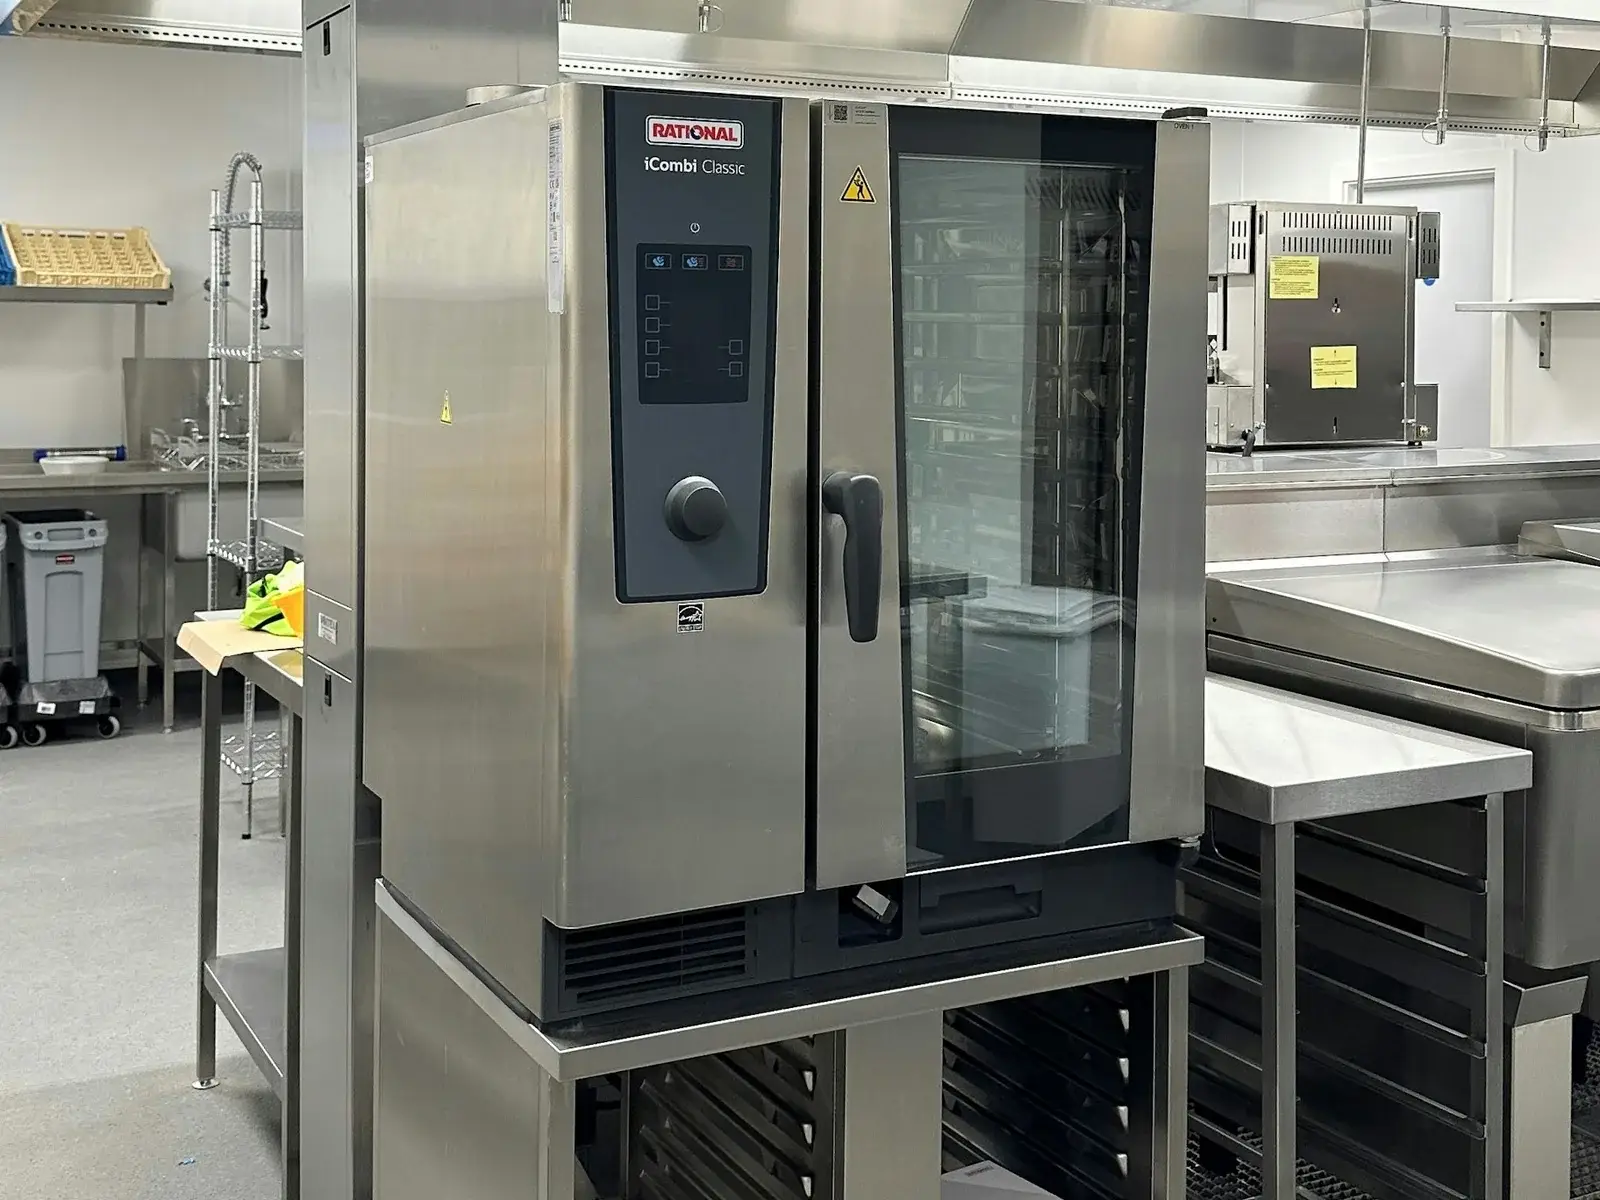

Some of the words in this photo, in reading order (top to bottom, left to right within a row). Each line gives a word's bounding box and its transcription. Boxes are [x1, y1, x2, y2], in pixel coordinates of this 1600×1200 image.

[652, 122, 738, 142] RATIONAL
[644, 156, 697, 173] iCombi
[702, 159, 745, 175] Classic
